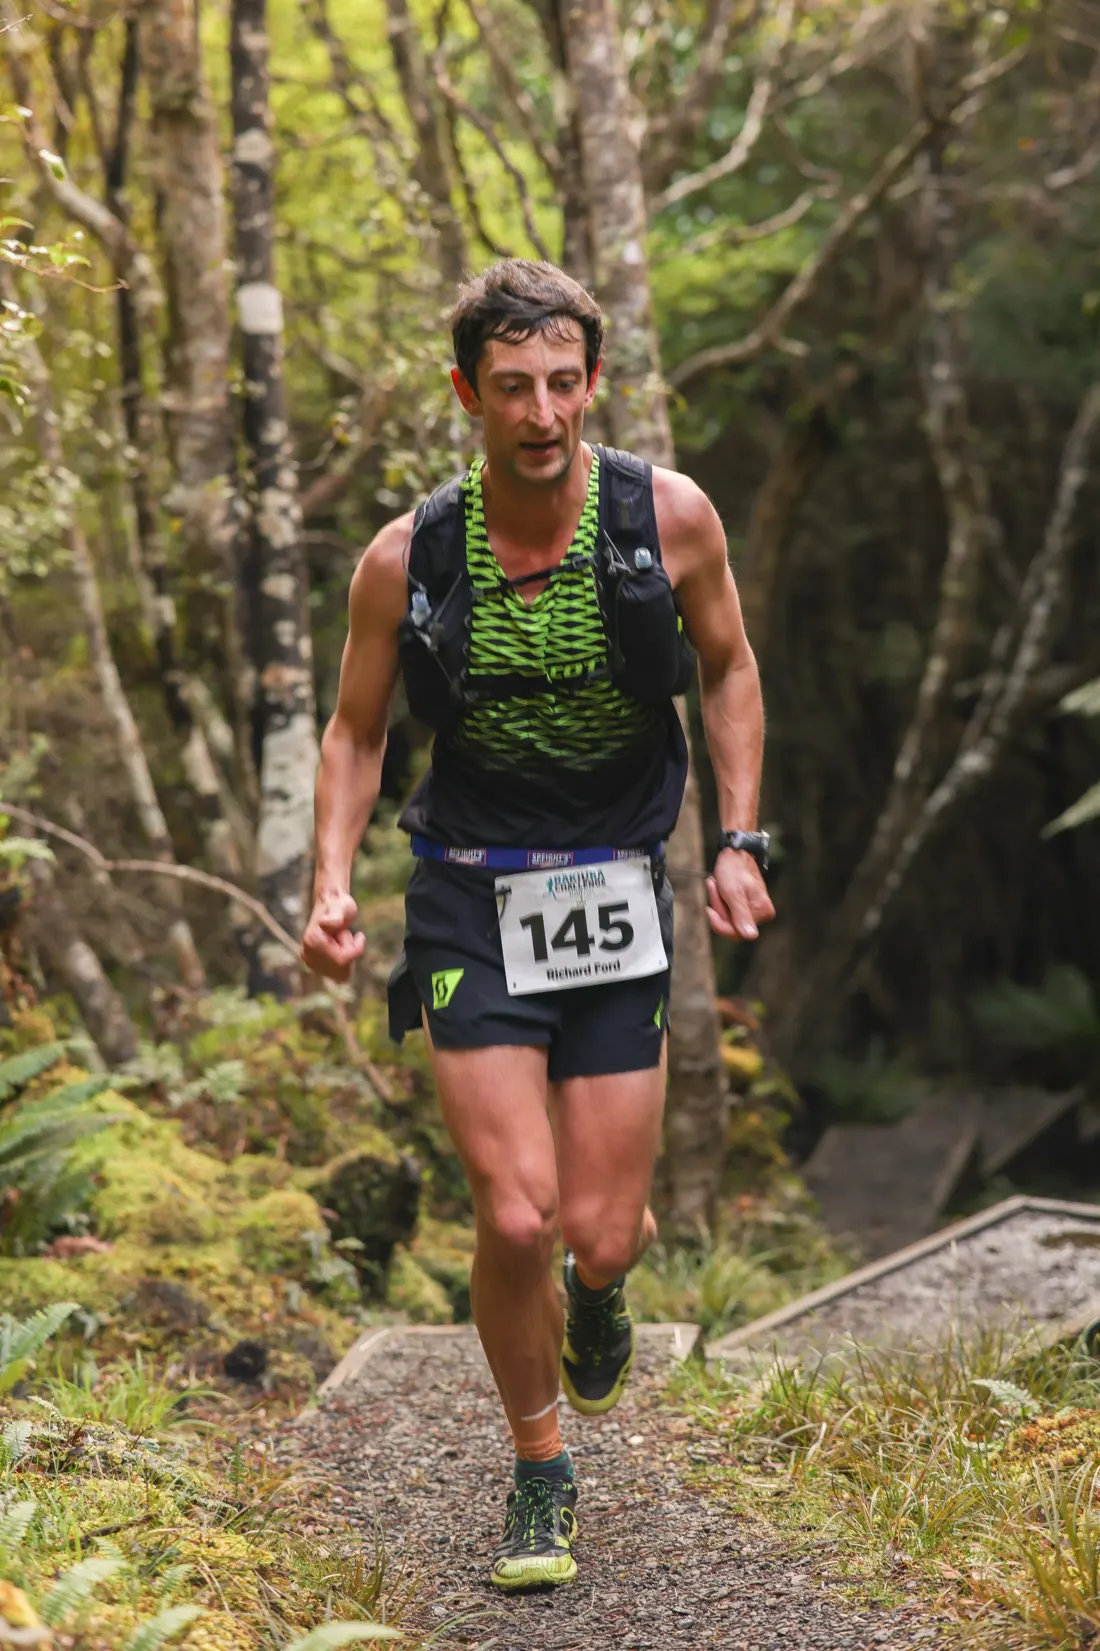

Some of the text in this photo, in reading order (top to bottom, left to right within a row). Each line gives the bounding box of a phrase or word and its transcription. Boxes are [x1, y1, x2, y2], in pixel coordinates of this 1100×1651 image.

[519, 899, 634, 963] 145
[546, 957, 621, 981] Richard Ford
